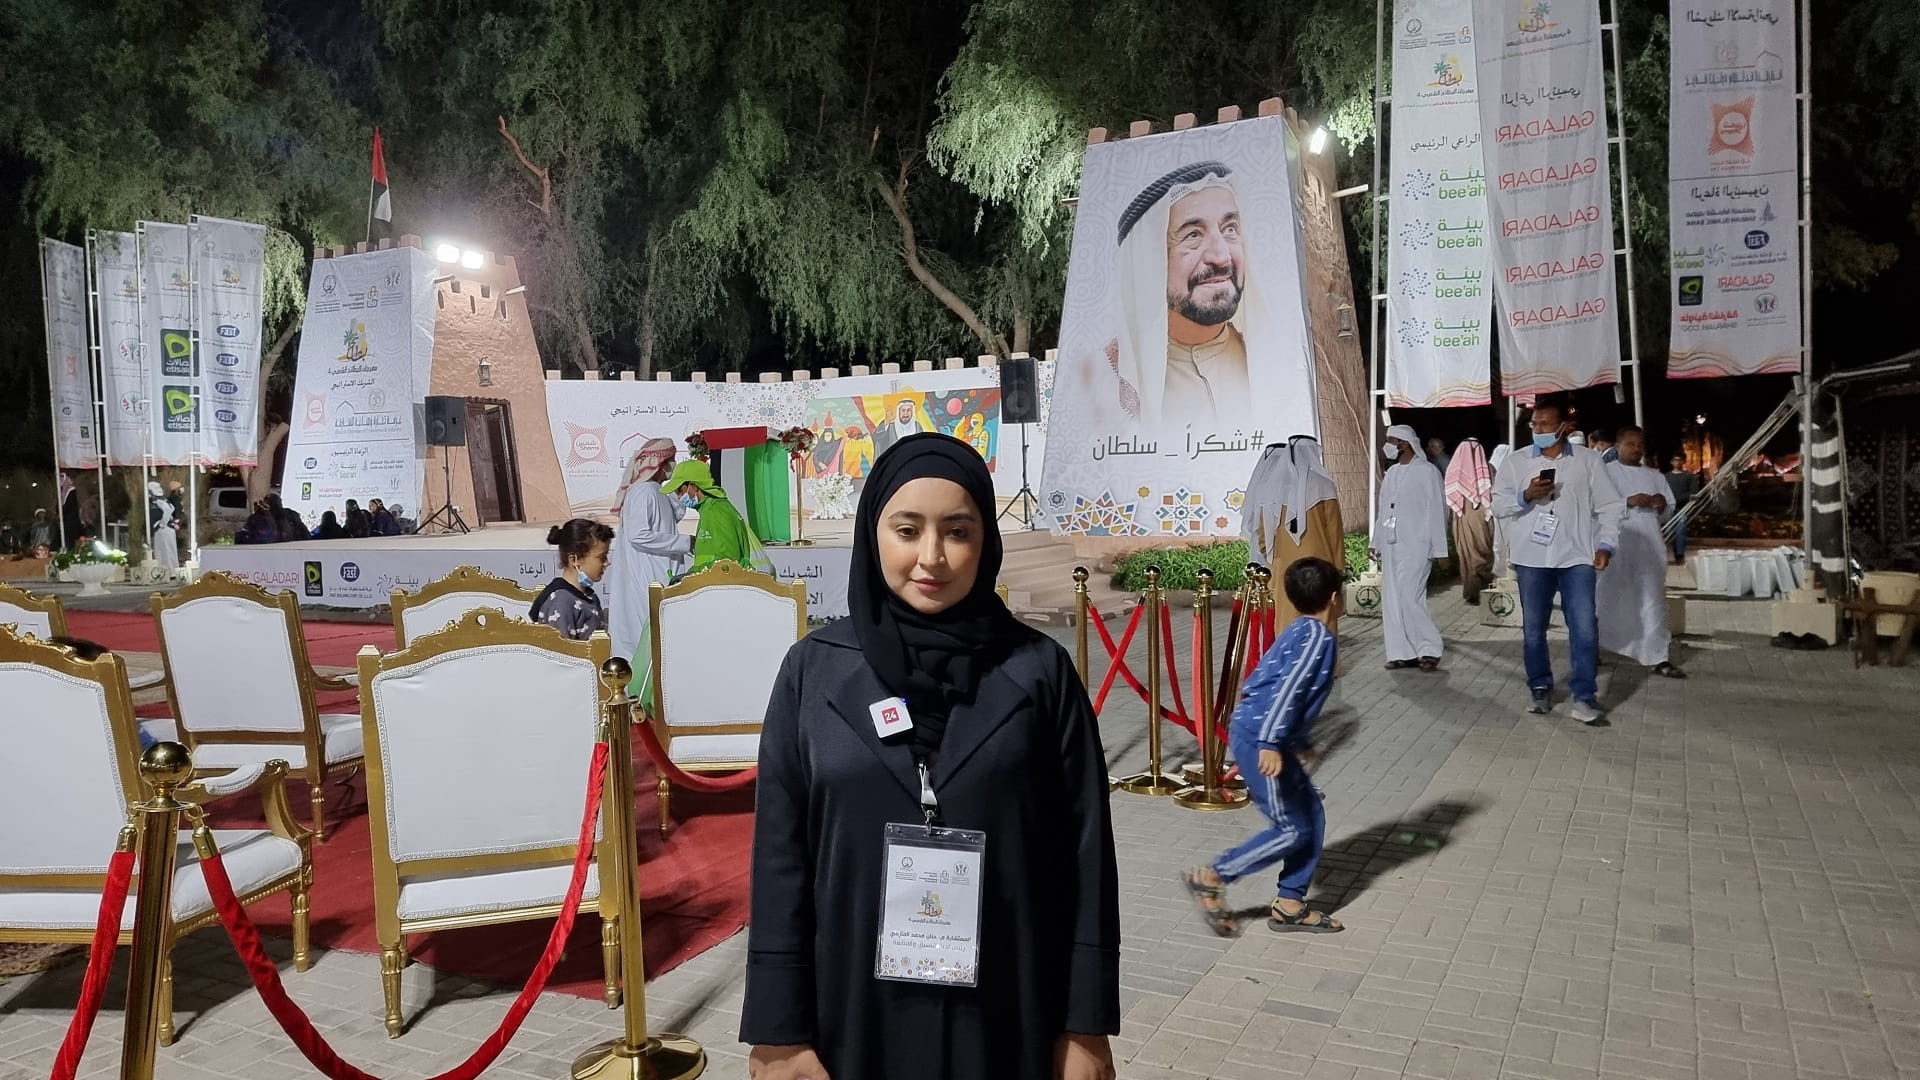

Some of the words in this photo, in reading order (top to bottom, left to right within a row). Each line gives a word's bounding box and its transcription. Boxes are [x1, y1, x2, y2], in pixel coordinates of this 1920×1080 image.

[1410, 136, 1448, 152] الرئيسي
[1451, 133, 1480, 150] الراعي
[1436, 234, 1483, 249] bee'ah
[1435, 284, 1481, 298] bee'ah
[1433, 333, 1480, 348] bee'ah
[610, 405, 657, 418] الاستراتيجي
[660, 404, 690, 417] الشريك
[1092, 434, 1158, 461] سلطان
[519, 562, 546, 578] الرعاة
[253, 571, 300, 585] GALADARI
[884, 710, 898, 721] 24
